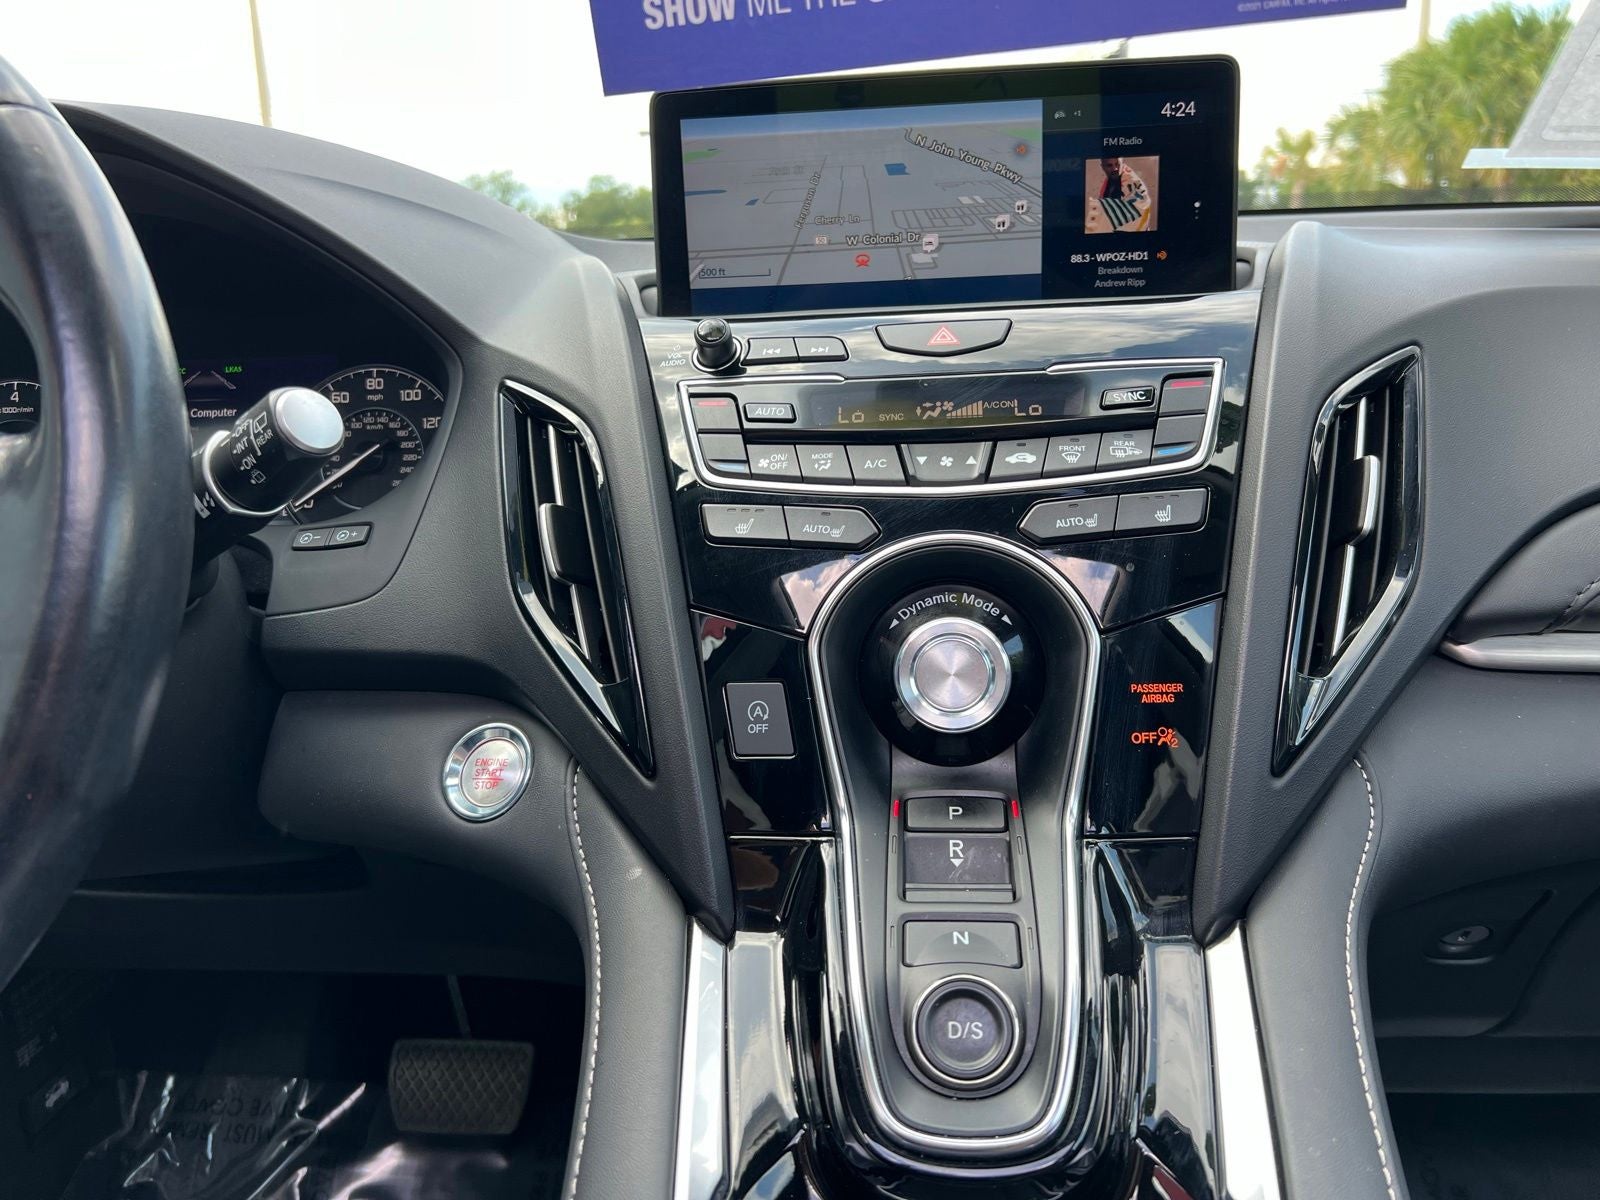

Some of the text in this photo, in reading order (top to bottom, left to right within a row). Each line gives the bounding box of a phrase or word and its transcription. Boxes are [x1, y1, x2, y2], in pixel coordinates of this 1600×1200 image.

[643, 0, 736, 30] SHOW
[1160, 101, 1196, 117] 4:24
[1103, 136, 1143, 146] FM Radio
[916, 135, 1021, 184] N John Young Pkwy
[810, 172, 821, 185] Dr
[815, 215, 860, 225] Cherry Ln
[846, 232, 920, 245] W Colonial Dr
[1070, 254, 1089, 263] 88.3
[1096, 252, 1148, 262] WPOZ-HD1
[701, 268, 717, 276] 500
[1097, 266, 1143, 275] Breakdown
[1094, 278, 1145, 288] Andrew Ripp
[660, 359, 686, 367] AUDIO
[366, 378, 383, 390] 80
[10, 391, 19, 402] 4
[332, 392, 349, 403] 60
[400, 390, 421, 401] 100
[1113, 391, 1146, 401] SYNC
[983, 401, 1000, 409] A/C
[190, 408, 237, 419] Computer
[754, 407, 785, 415] AUTO
[879, 413, 904, 422] SYNC
[256, 429, 274, 447] REAR
[236, 436, 249, 454] INT
[243, 454, 257, 470] ON
[770, 454, 788, 462] ON/
[770, 462, 789, 470] OFF
[864, 459, 887, 469] A/C
[1056, 517, 1084, 528] AUTO
[803, 524, 830, 534] AUTO
[898, 592, 1000, 620] Dynamic Mode
[1131, 683, 1184, 693] PASSENGER
[1141, 694, 1175, 703] AIRBAG
[748, 724, 769, 733] OFF
[1131, 732, 1157, 744] OFF
[475, 758, 509, 767] ENGINE
[475, 769, 505, 777] START
[475, 780, 499, 789] STOP
[949, 806, 963, 820] P
[949, 840, 964, 858] R
[953, 931, 969, 945] N
[947, 1021, 984, 1039] D/S
